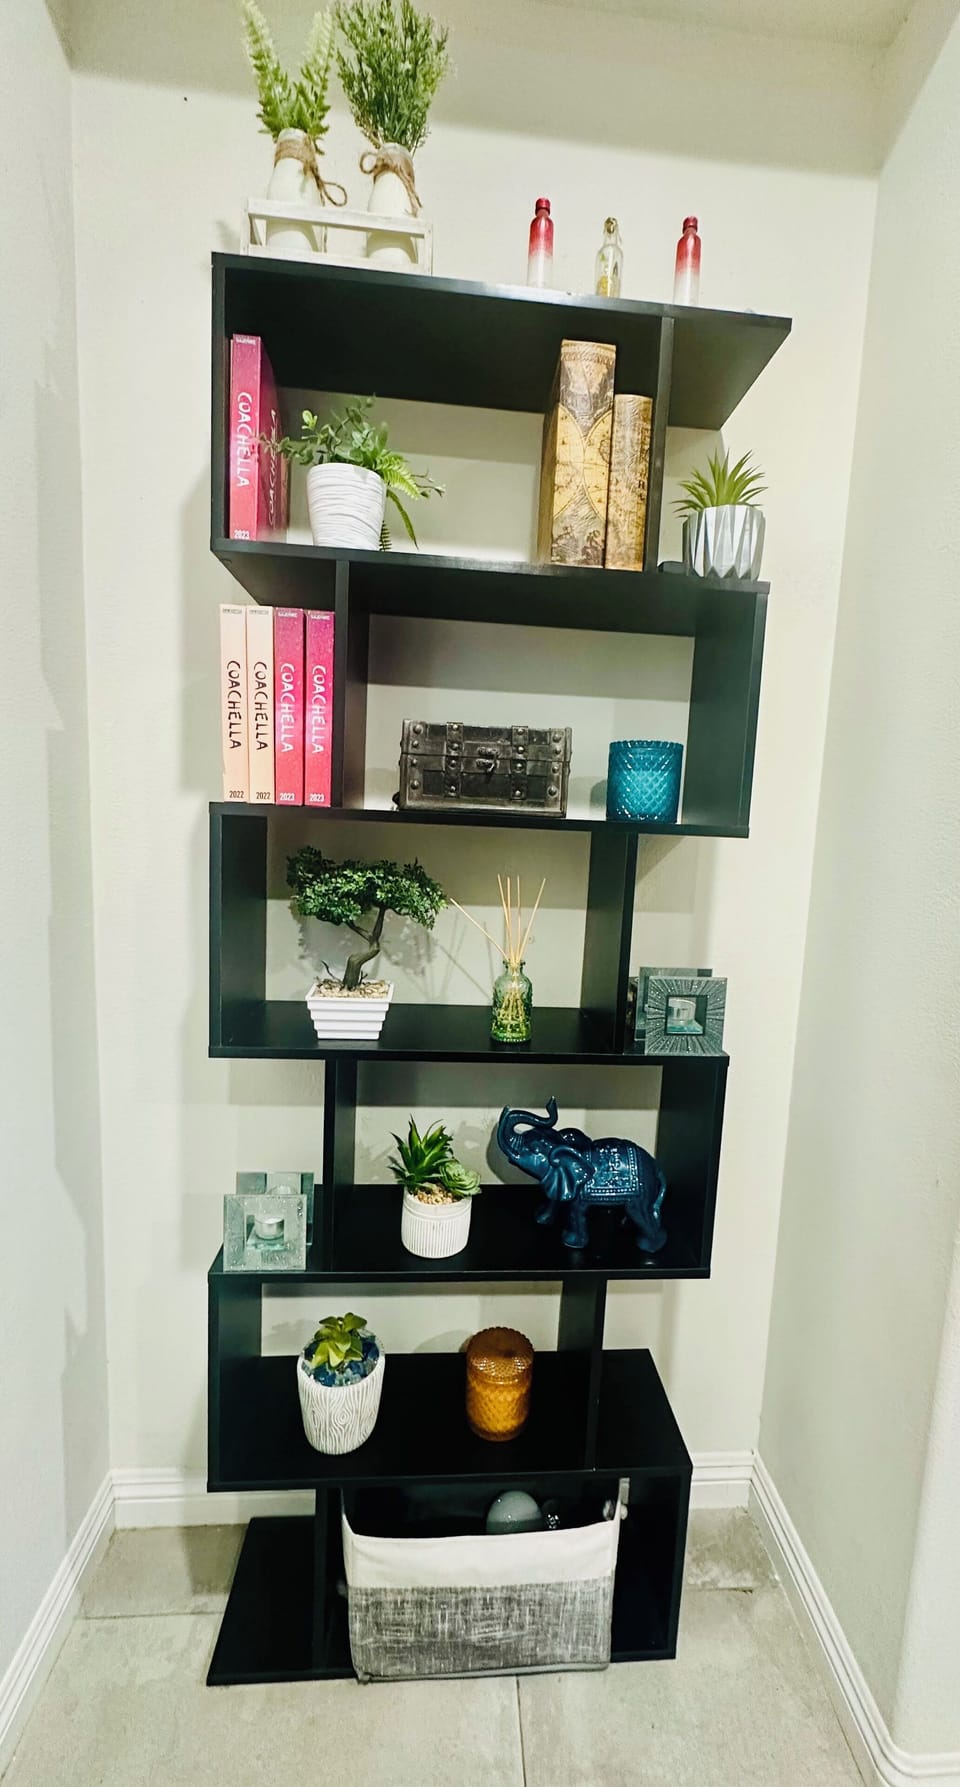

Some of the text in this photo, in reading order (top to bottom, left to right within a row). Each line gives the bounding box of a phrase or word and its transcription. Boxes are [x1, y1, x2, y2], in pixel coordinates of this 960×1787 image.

[237, 392, 253, 487] COACHELLA
[226, 660, 242, 749] COACHELLA
[254, 661, 269, 751] COACHELLA
[280, 662, 296, 753] COACHELLA
[311, 665, 327, 754] COACHELLA
[229, 790, 244, 799] 2022
[256, 791, 271, 800] 2022
